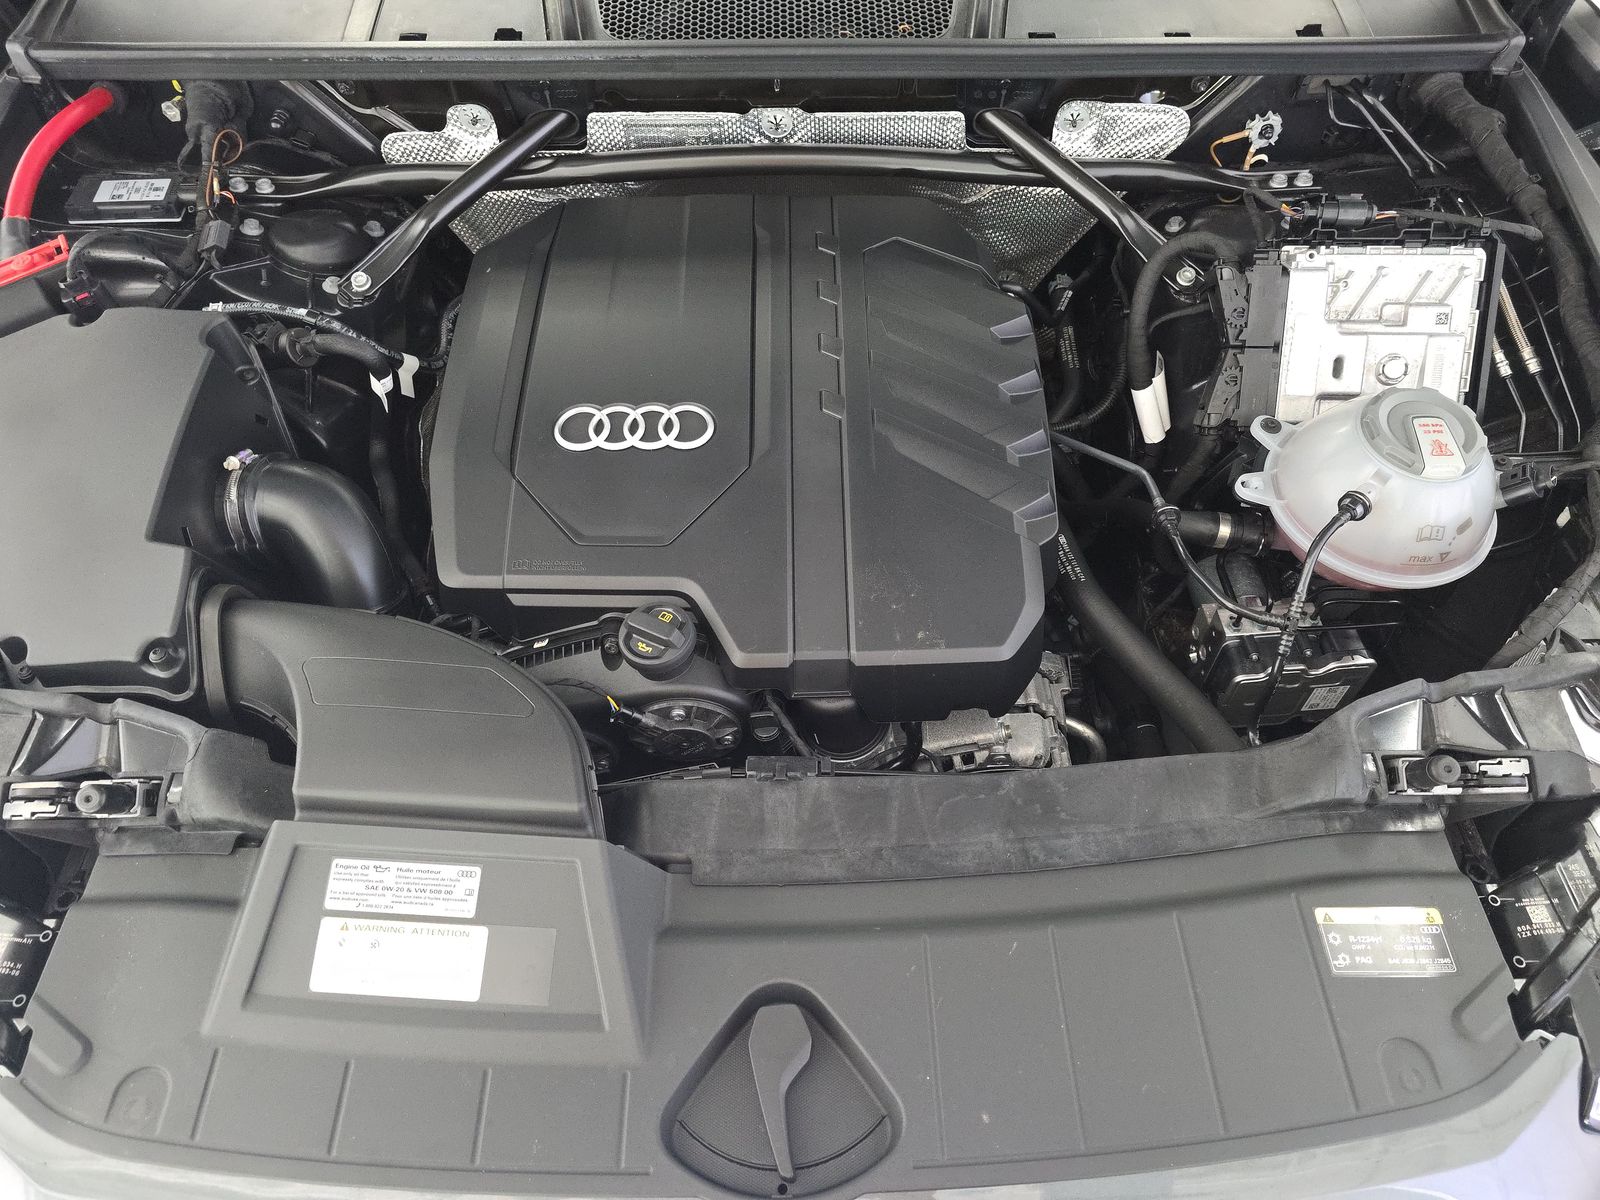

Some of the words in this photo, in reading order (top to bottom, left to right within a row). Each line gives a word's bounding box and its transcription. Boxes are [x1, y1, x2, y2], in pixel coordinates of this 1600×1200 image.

[353, 923, 406, 934] WARNING
[411, 926, 471, 938] ATTENTION
[1421, 935, 1432, 945] kg
[1355, 956, 1373, 964] PAG
